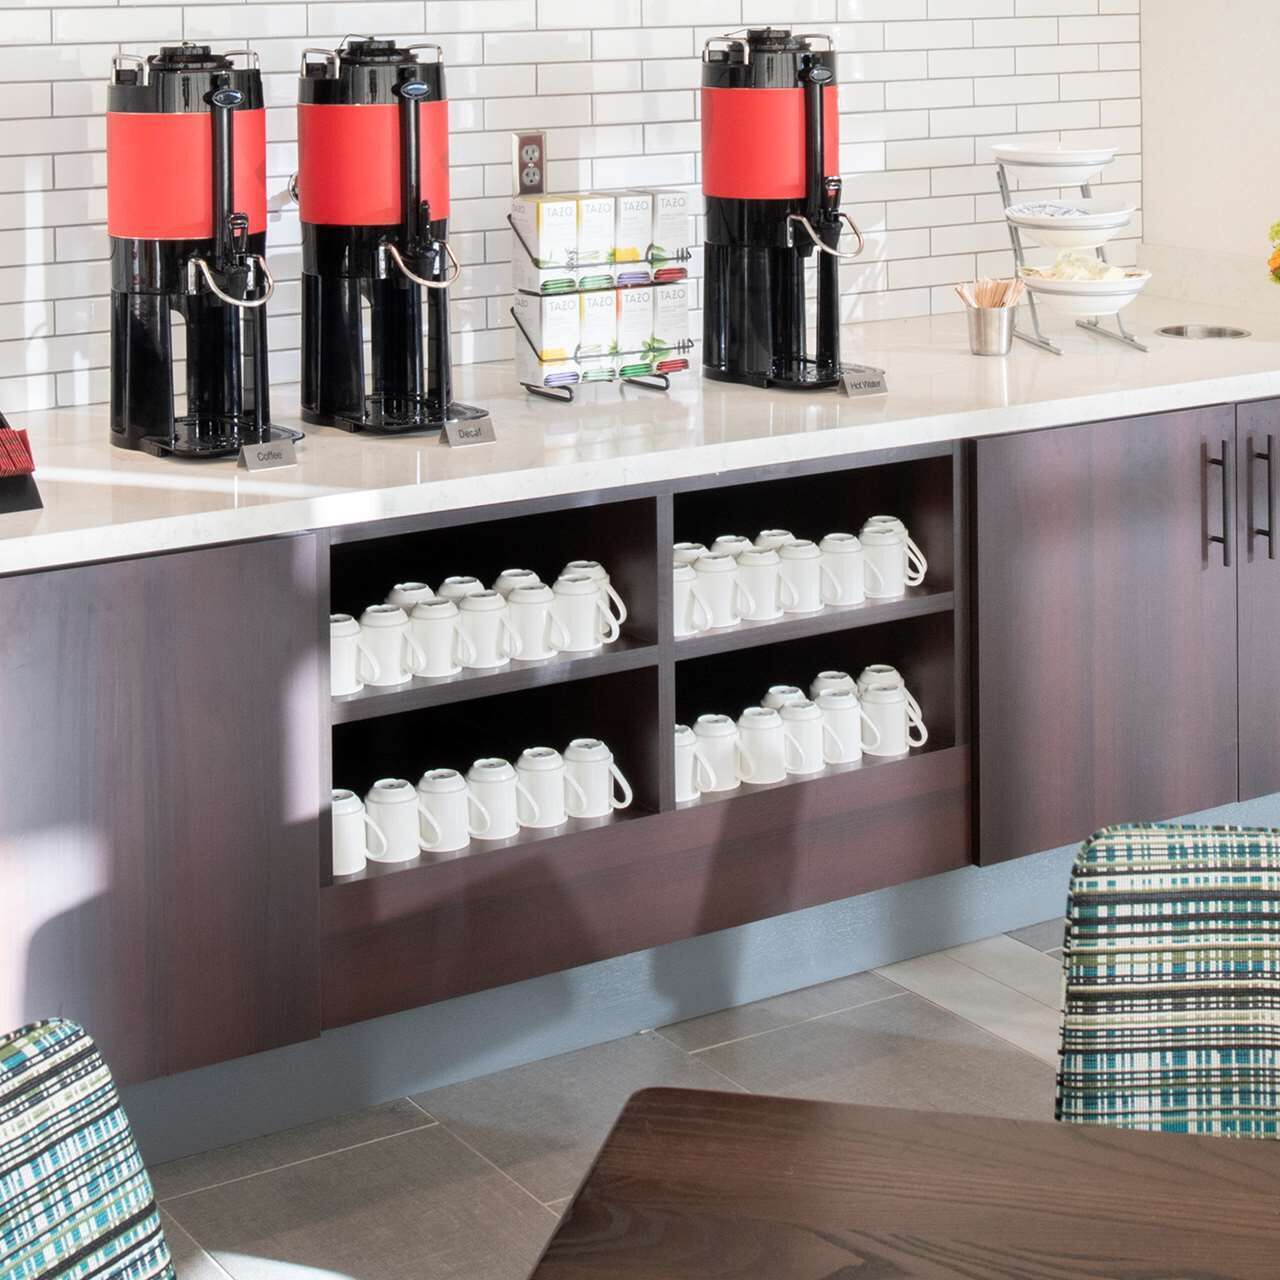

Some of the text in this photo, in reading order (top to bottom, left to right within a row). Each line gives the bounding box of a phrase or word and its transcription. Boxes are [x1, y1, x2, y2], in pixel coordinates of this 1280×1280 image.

[585, 202, 612, 214] TAZO
[623, 200, 649, 212] TAZO
[660, 197, 686, 209] TAZO
[546, 206, 574, 218] TAZO
[625, 292, 650, 304] TAZO
[660, 288, 686, 300] TAZO
[549, 301, 576, 312] TAZO
[587, 296, 614, 308] TAZO
[458, 427, 481, 439] Decaf
[257, 450, 283, 462] Coffee
